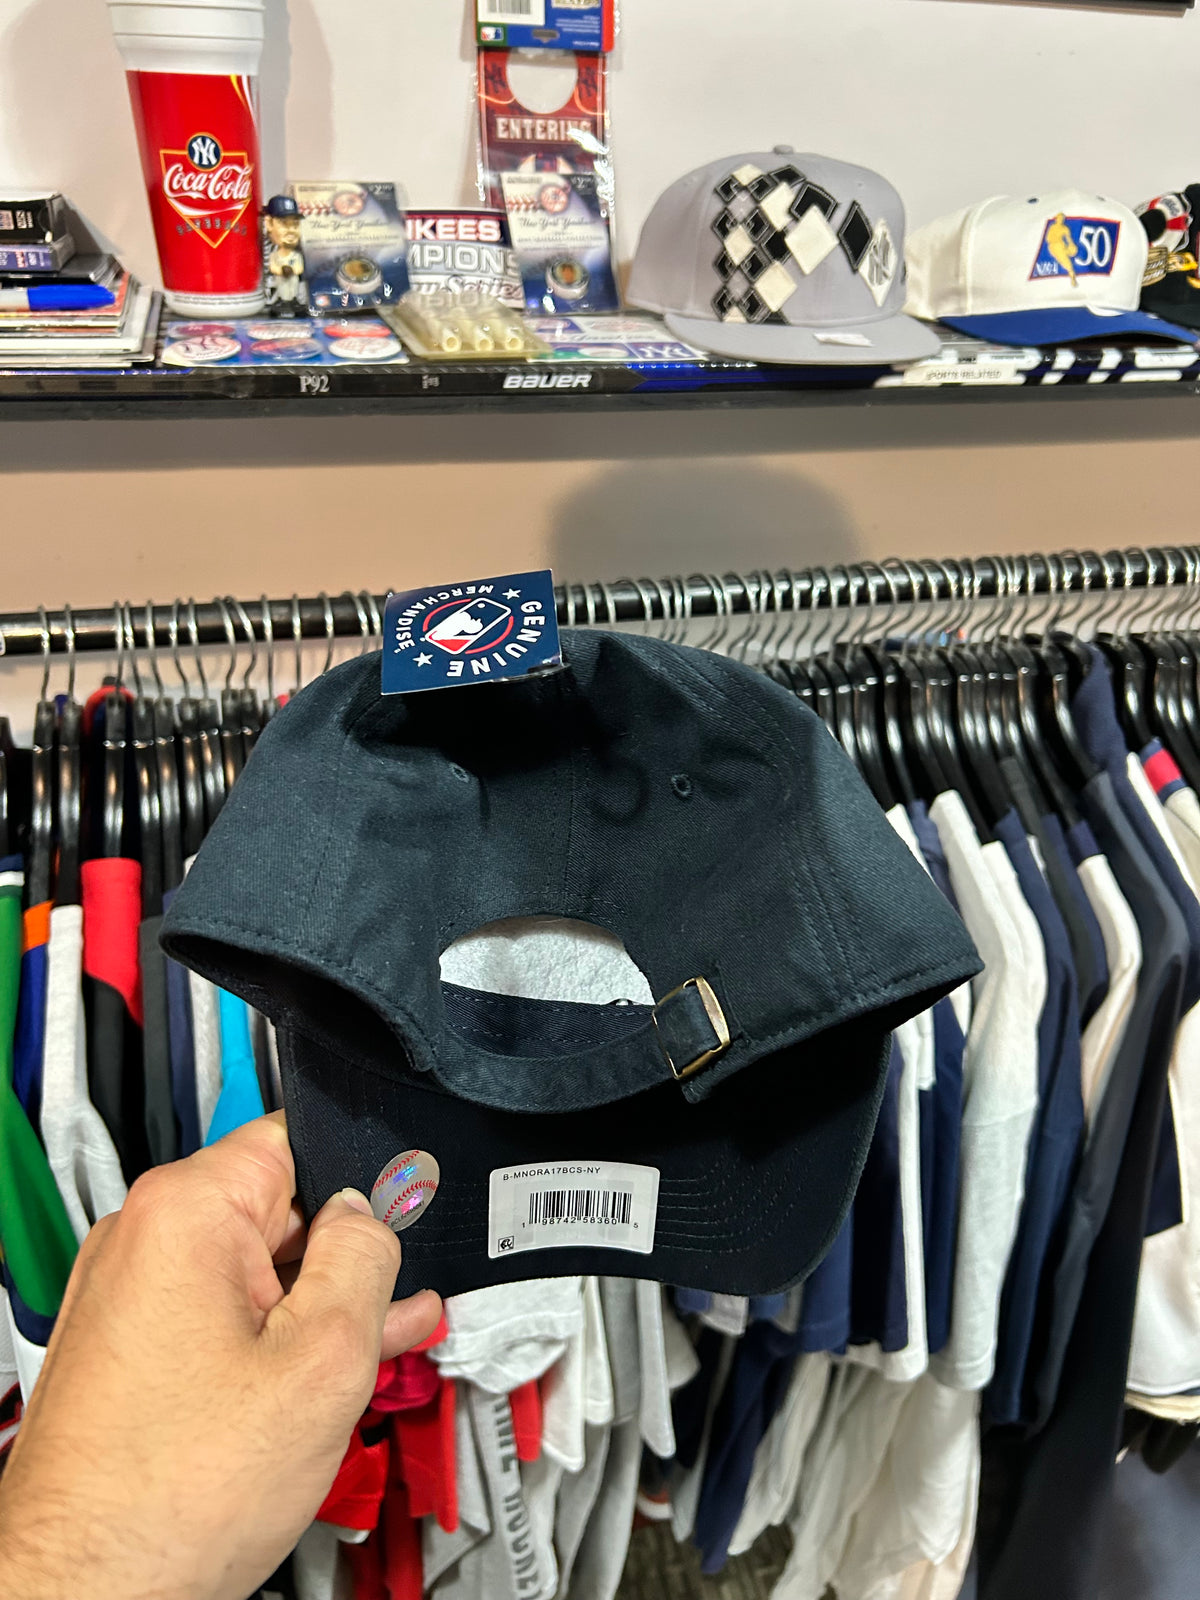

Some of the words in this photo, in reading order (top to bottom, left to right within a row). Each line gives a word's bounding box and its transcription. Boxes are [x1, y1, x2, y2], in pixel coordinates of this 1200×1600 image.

[163, 163, 253, 200] Coca-Cola
[405, 218, 500, 242] KEES
[1074, 226, 1111, 267] 50
[299, 376, 330, 394] P92
[503, 373, 592, 389] BAUER
[446, 600, 545, 677] GENUINE
[503, 1165, 601, 1181] B-MNORA17BCS-NY
[542, 1215, 576, 1226] 98742
